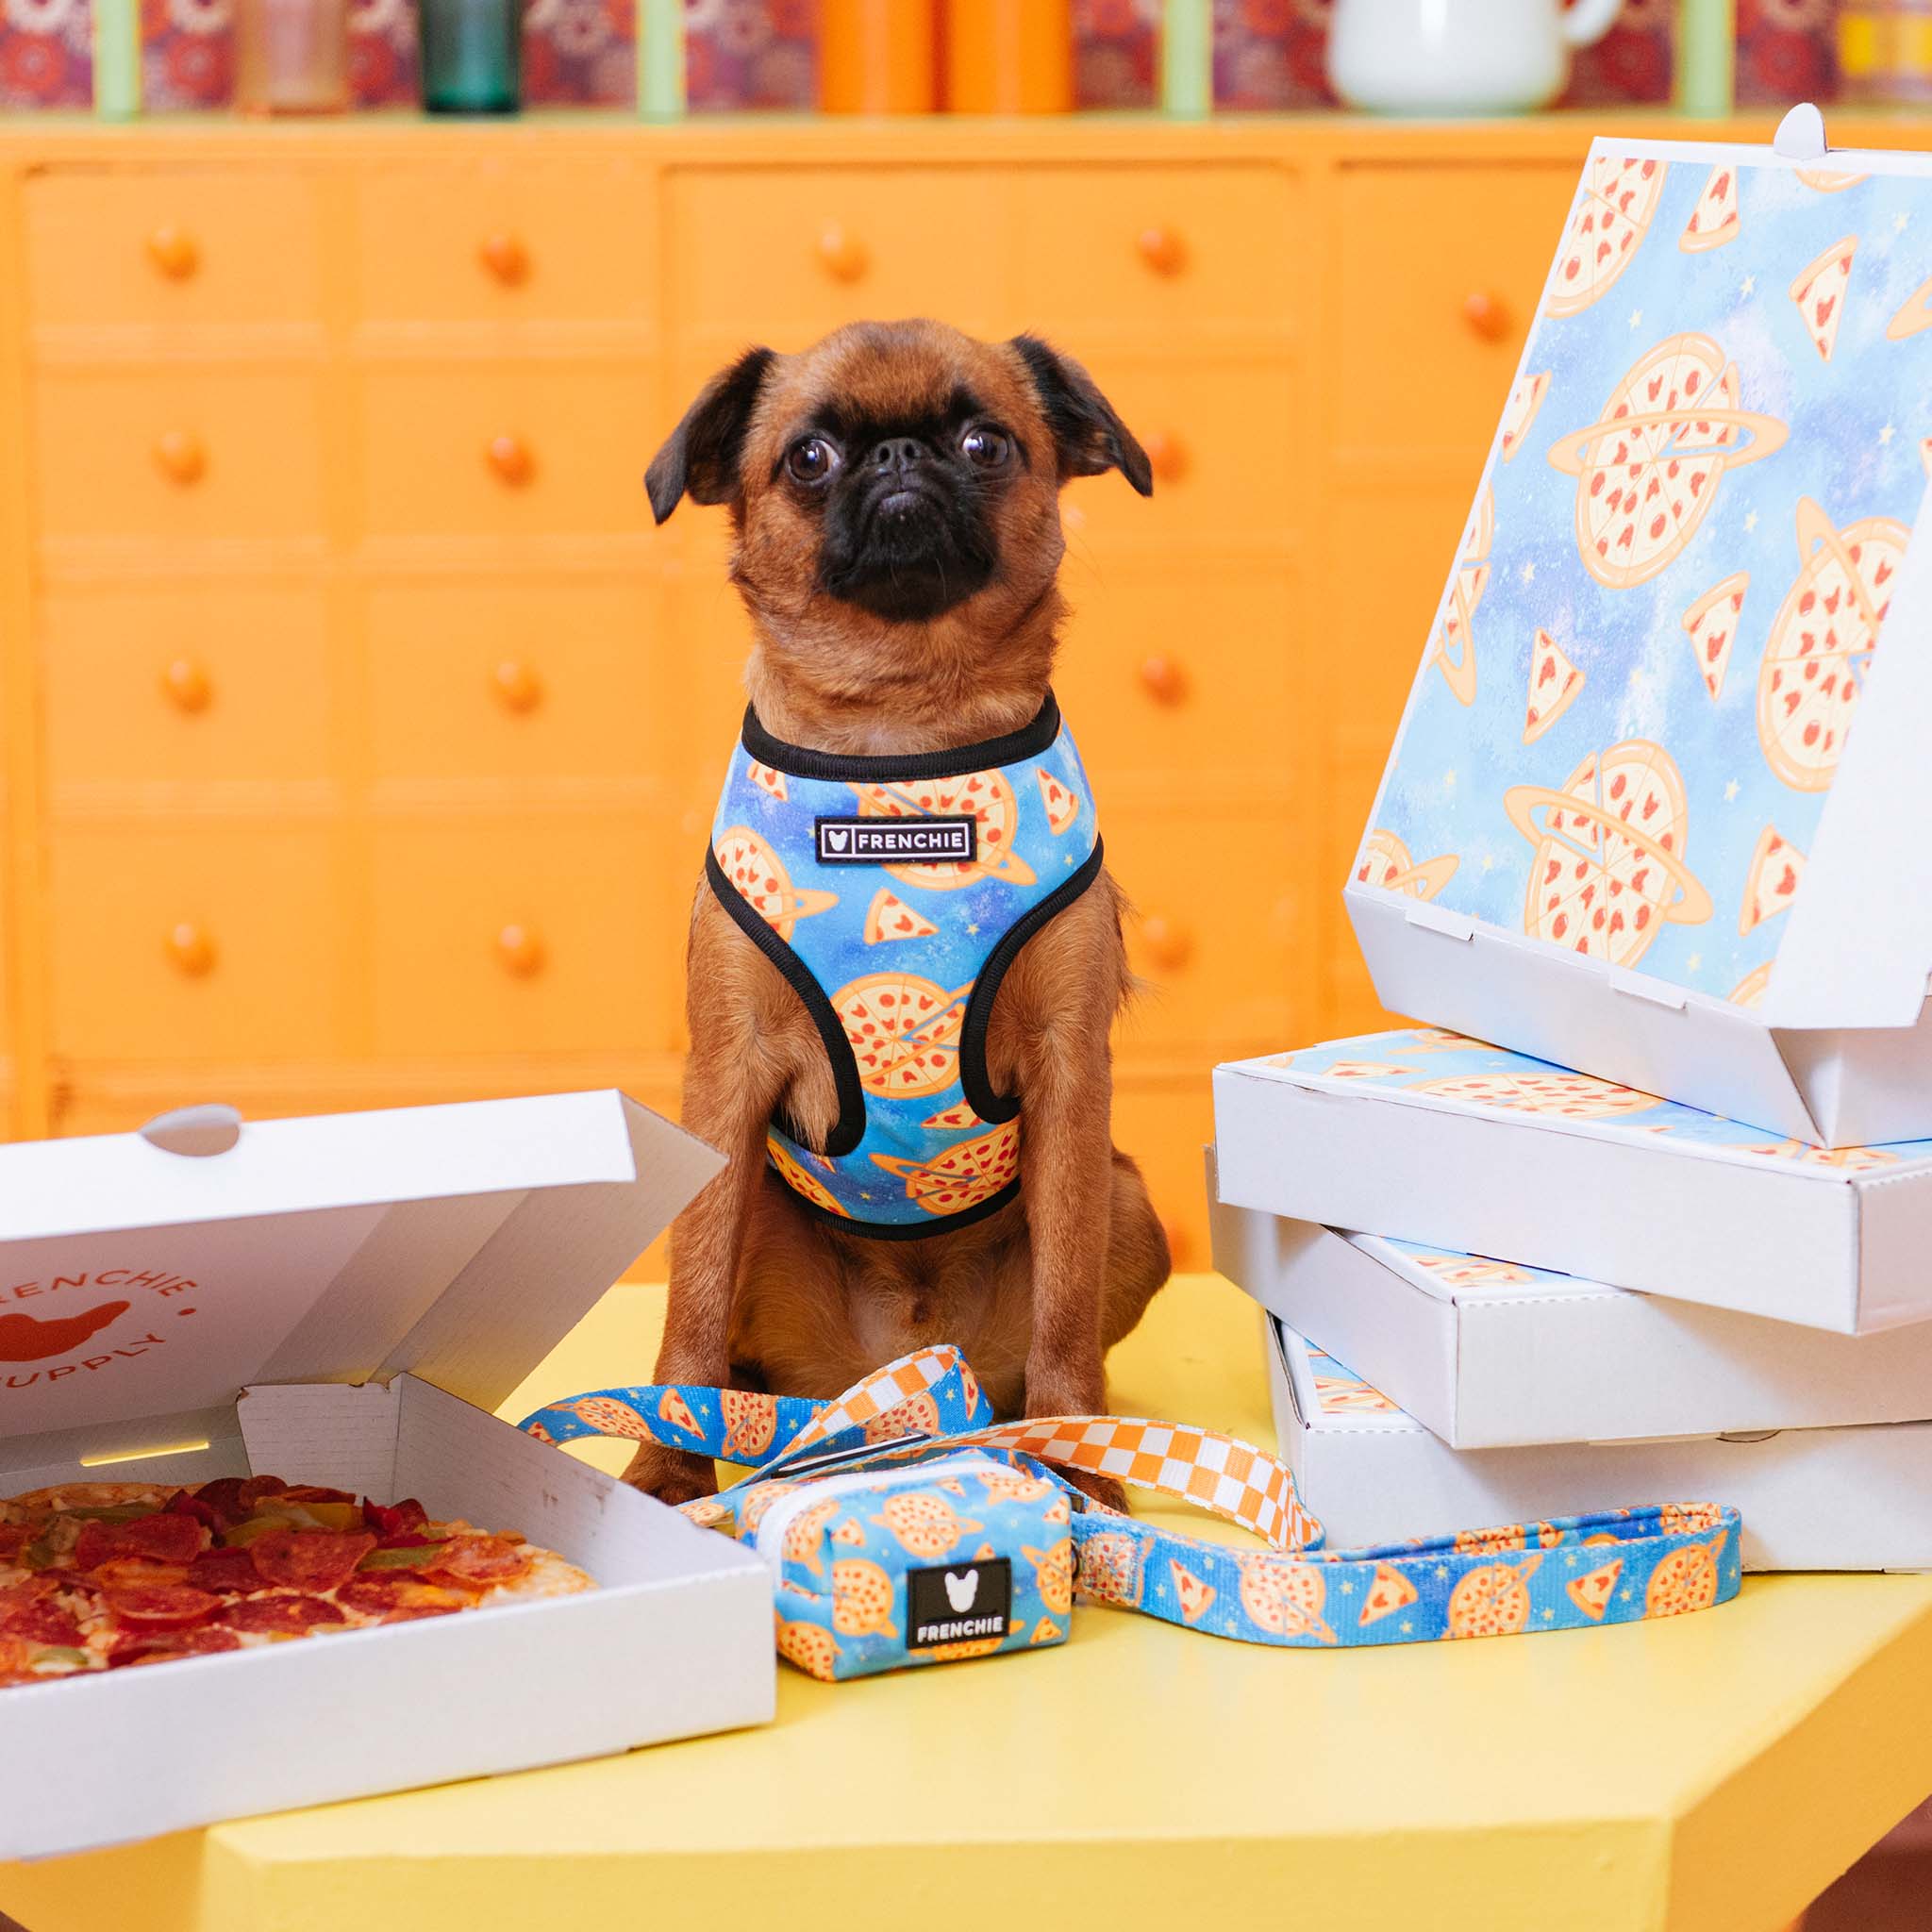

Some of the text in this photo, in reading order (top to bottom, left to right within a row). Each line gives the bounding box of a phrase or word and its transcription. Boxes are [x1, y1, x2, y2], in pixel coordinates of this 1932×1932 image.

[858, 832, 963, 849] FRENCHIE
[0, 1333, 166, 1388] UPPLY
[917, 1616, 1004, 1642] FRENCHIE
